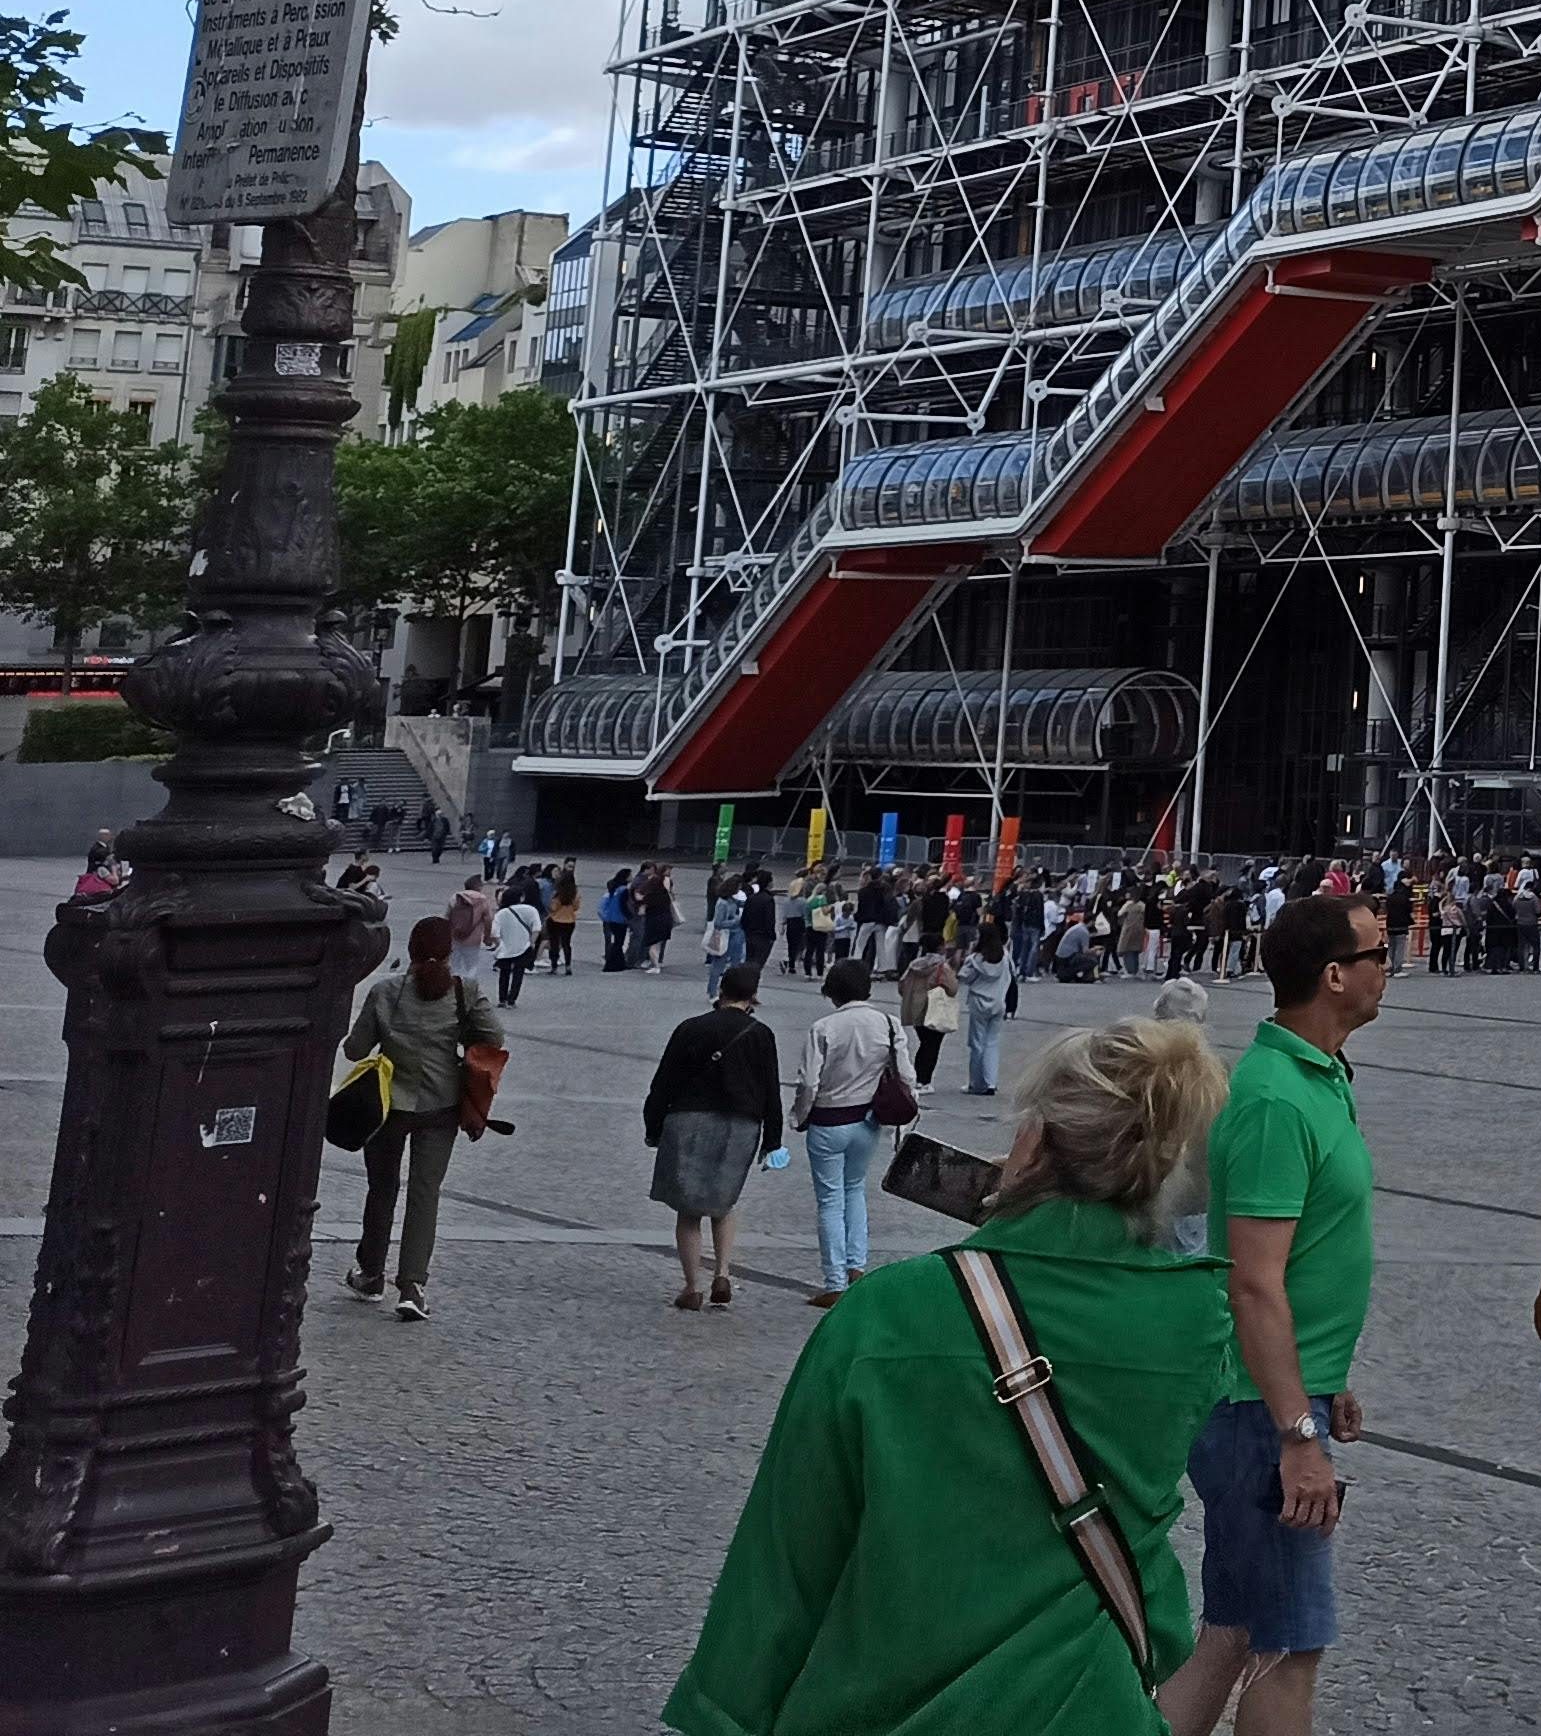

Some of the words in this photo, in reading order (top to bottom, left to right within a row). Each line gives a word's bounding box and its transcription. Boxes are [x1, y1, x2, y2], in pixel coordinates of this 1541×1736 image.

[267, 33, 279, 52] et
[254, 65, 267, 82] et
[227, 90, 278, 111] Diffusion
[281, 89, 308, 107] avc
[249, 145, 321, 165] Permanence
